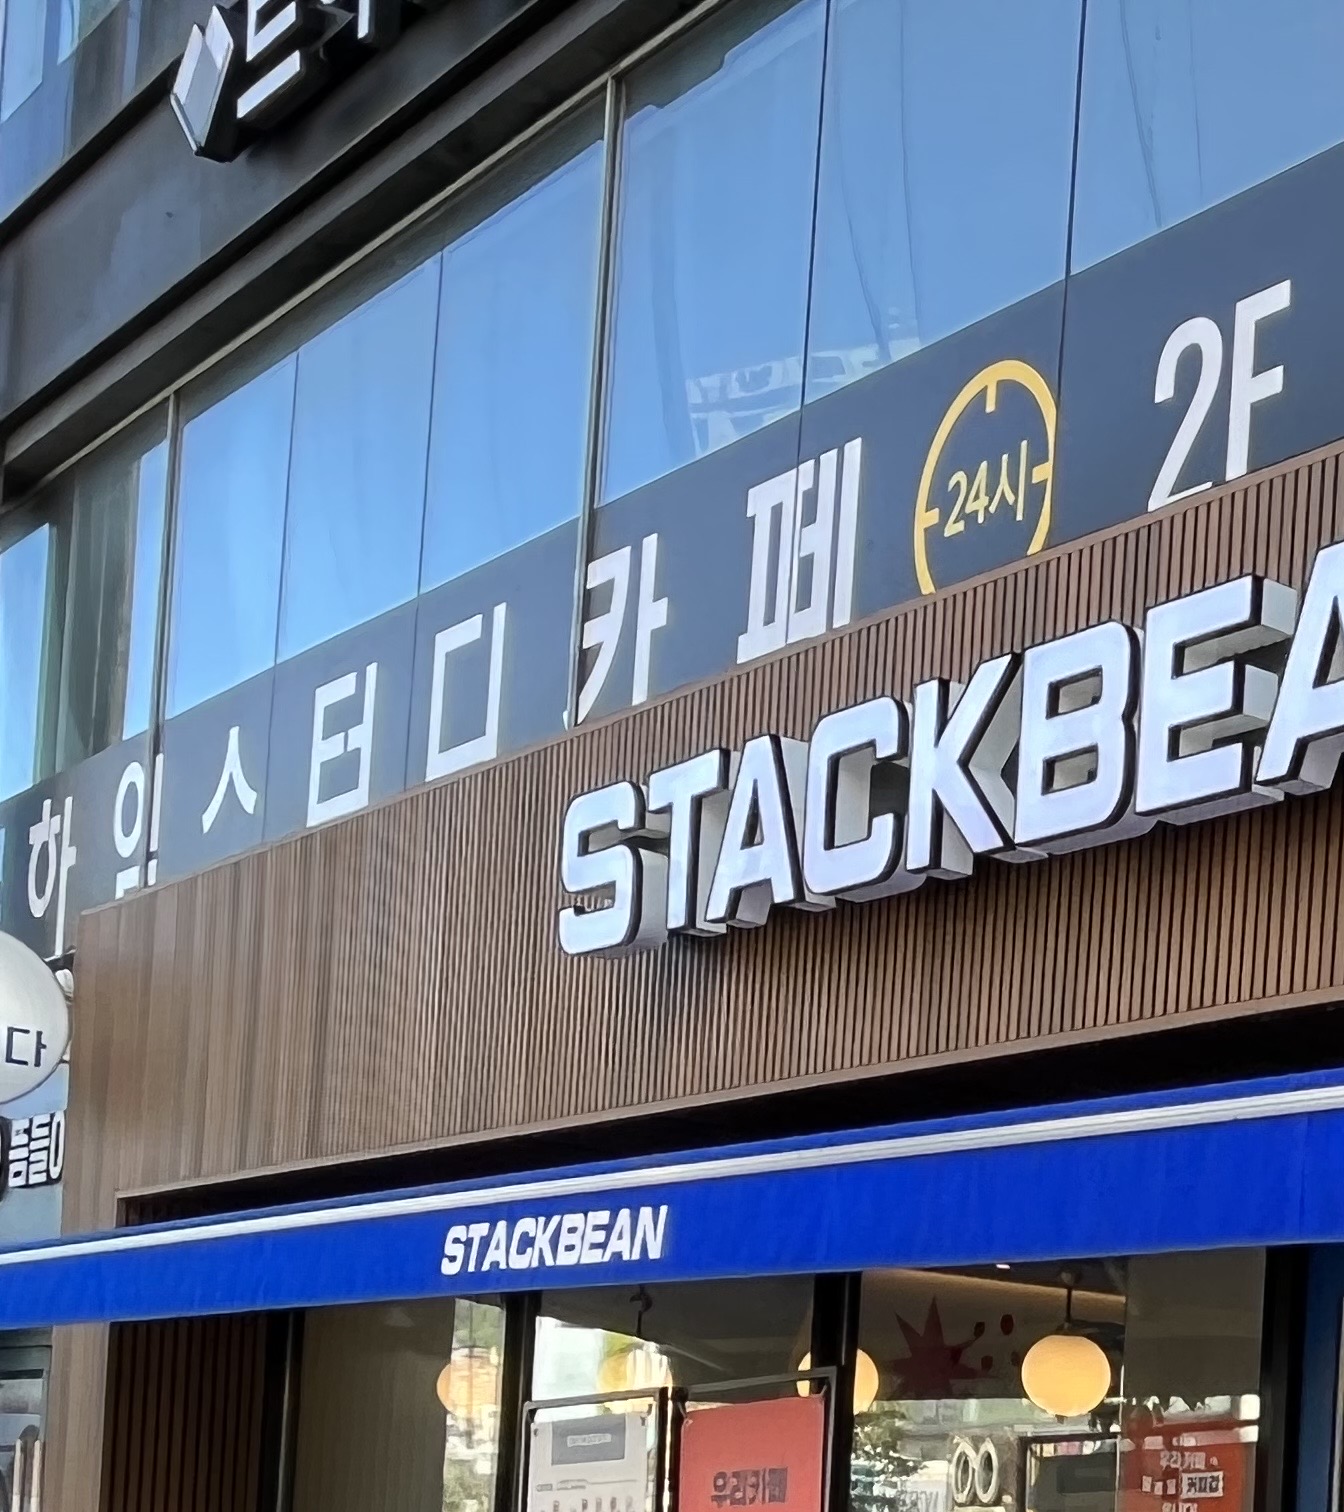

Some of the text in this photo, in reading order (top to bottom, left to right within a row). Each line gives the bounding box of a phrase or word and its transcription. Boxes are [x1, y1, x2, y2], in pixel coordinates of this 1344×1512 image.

[944, 440, 1028, 537] 24시
[1147, 279, 1291, 512] 2F
[5, 1026, 47, 1067] 다
[441, 1205, 668, 1275] STACKBEAN
